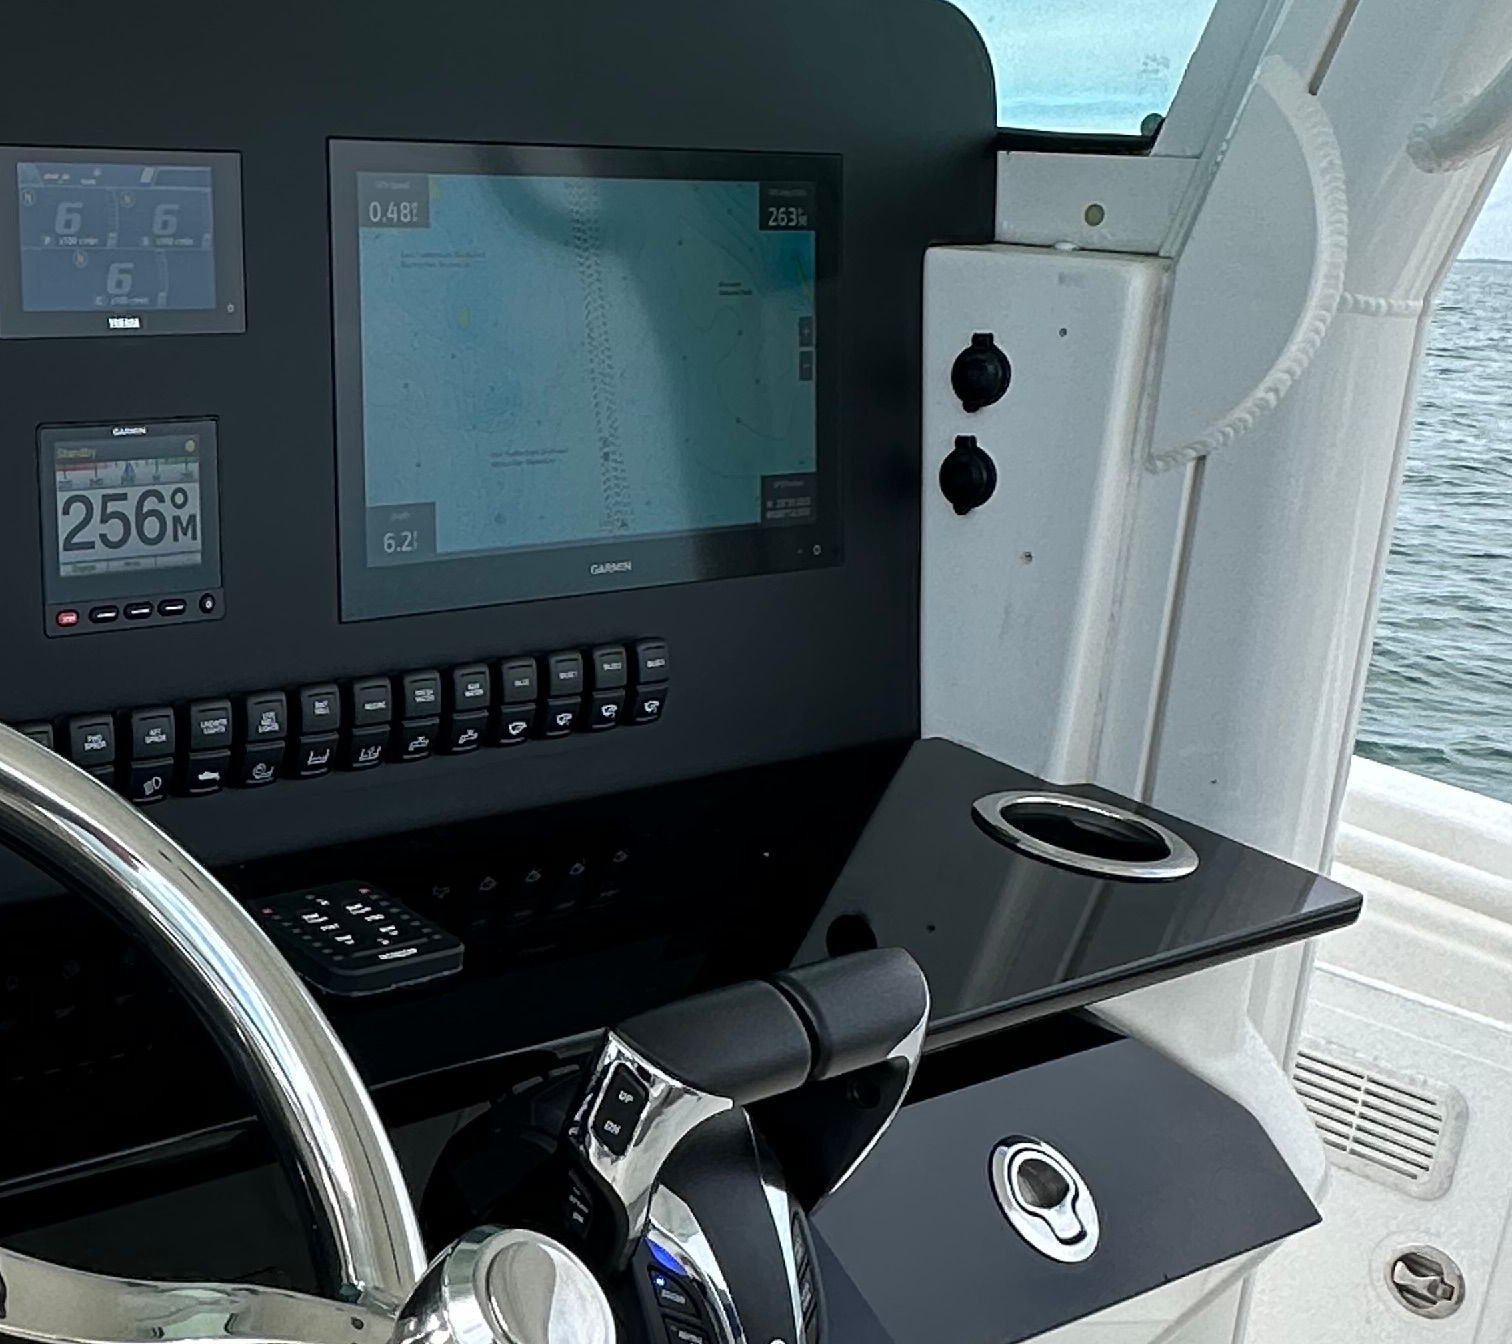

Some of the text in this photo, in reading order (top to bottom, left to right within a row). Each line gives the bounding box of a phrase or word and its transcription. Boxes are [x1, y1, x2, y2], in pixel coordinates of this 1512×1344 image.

[55, 202, 84, 236] 6
[152, 204, 180, 236] 6
[369, 201, 411, 223] 0.48
[107, 262, 135, 296] 6
[384, 530, 413, 553] 6.2
[618, 1090, 634, 1104] UP
